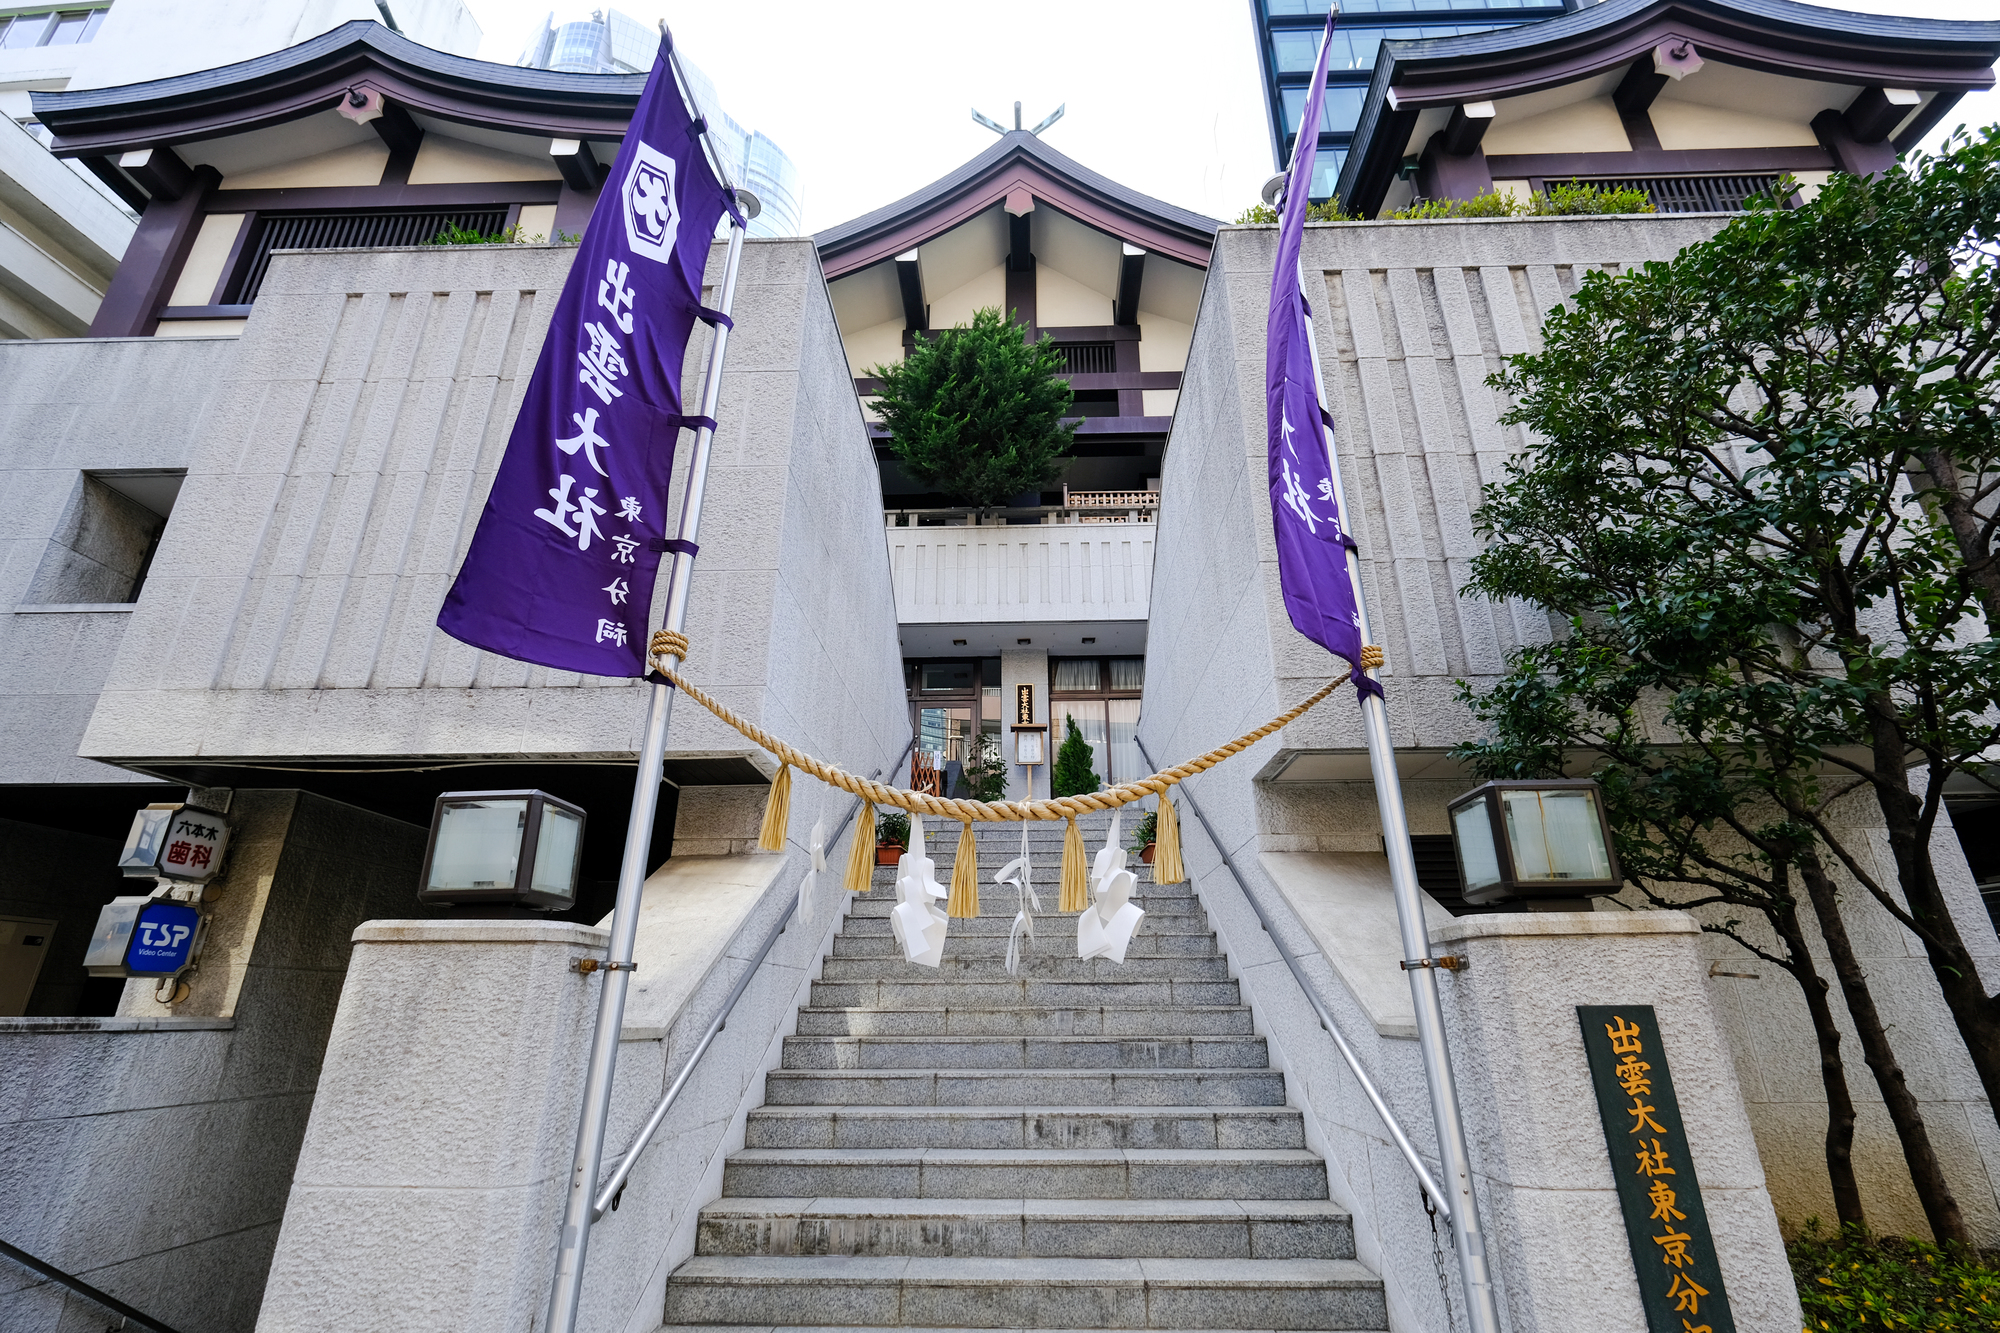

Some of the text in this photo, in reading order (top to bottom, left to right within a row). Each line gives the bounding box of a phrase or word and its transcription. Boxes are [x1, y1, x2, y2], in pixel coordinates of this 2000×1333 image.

[176, 820, 219, 841] 六本木
[167, 840, 213, 869] 歯科
[140, 921, 190, 948] TSP
[138, 948, 178, 958] Video Center
[1604, 1015, 1713, 1333] 出雲大社東京分
